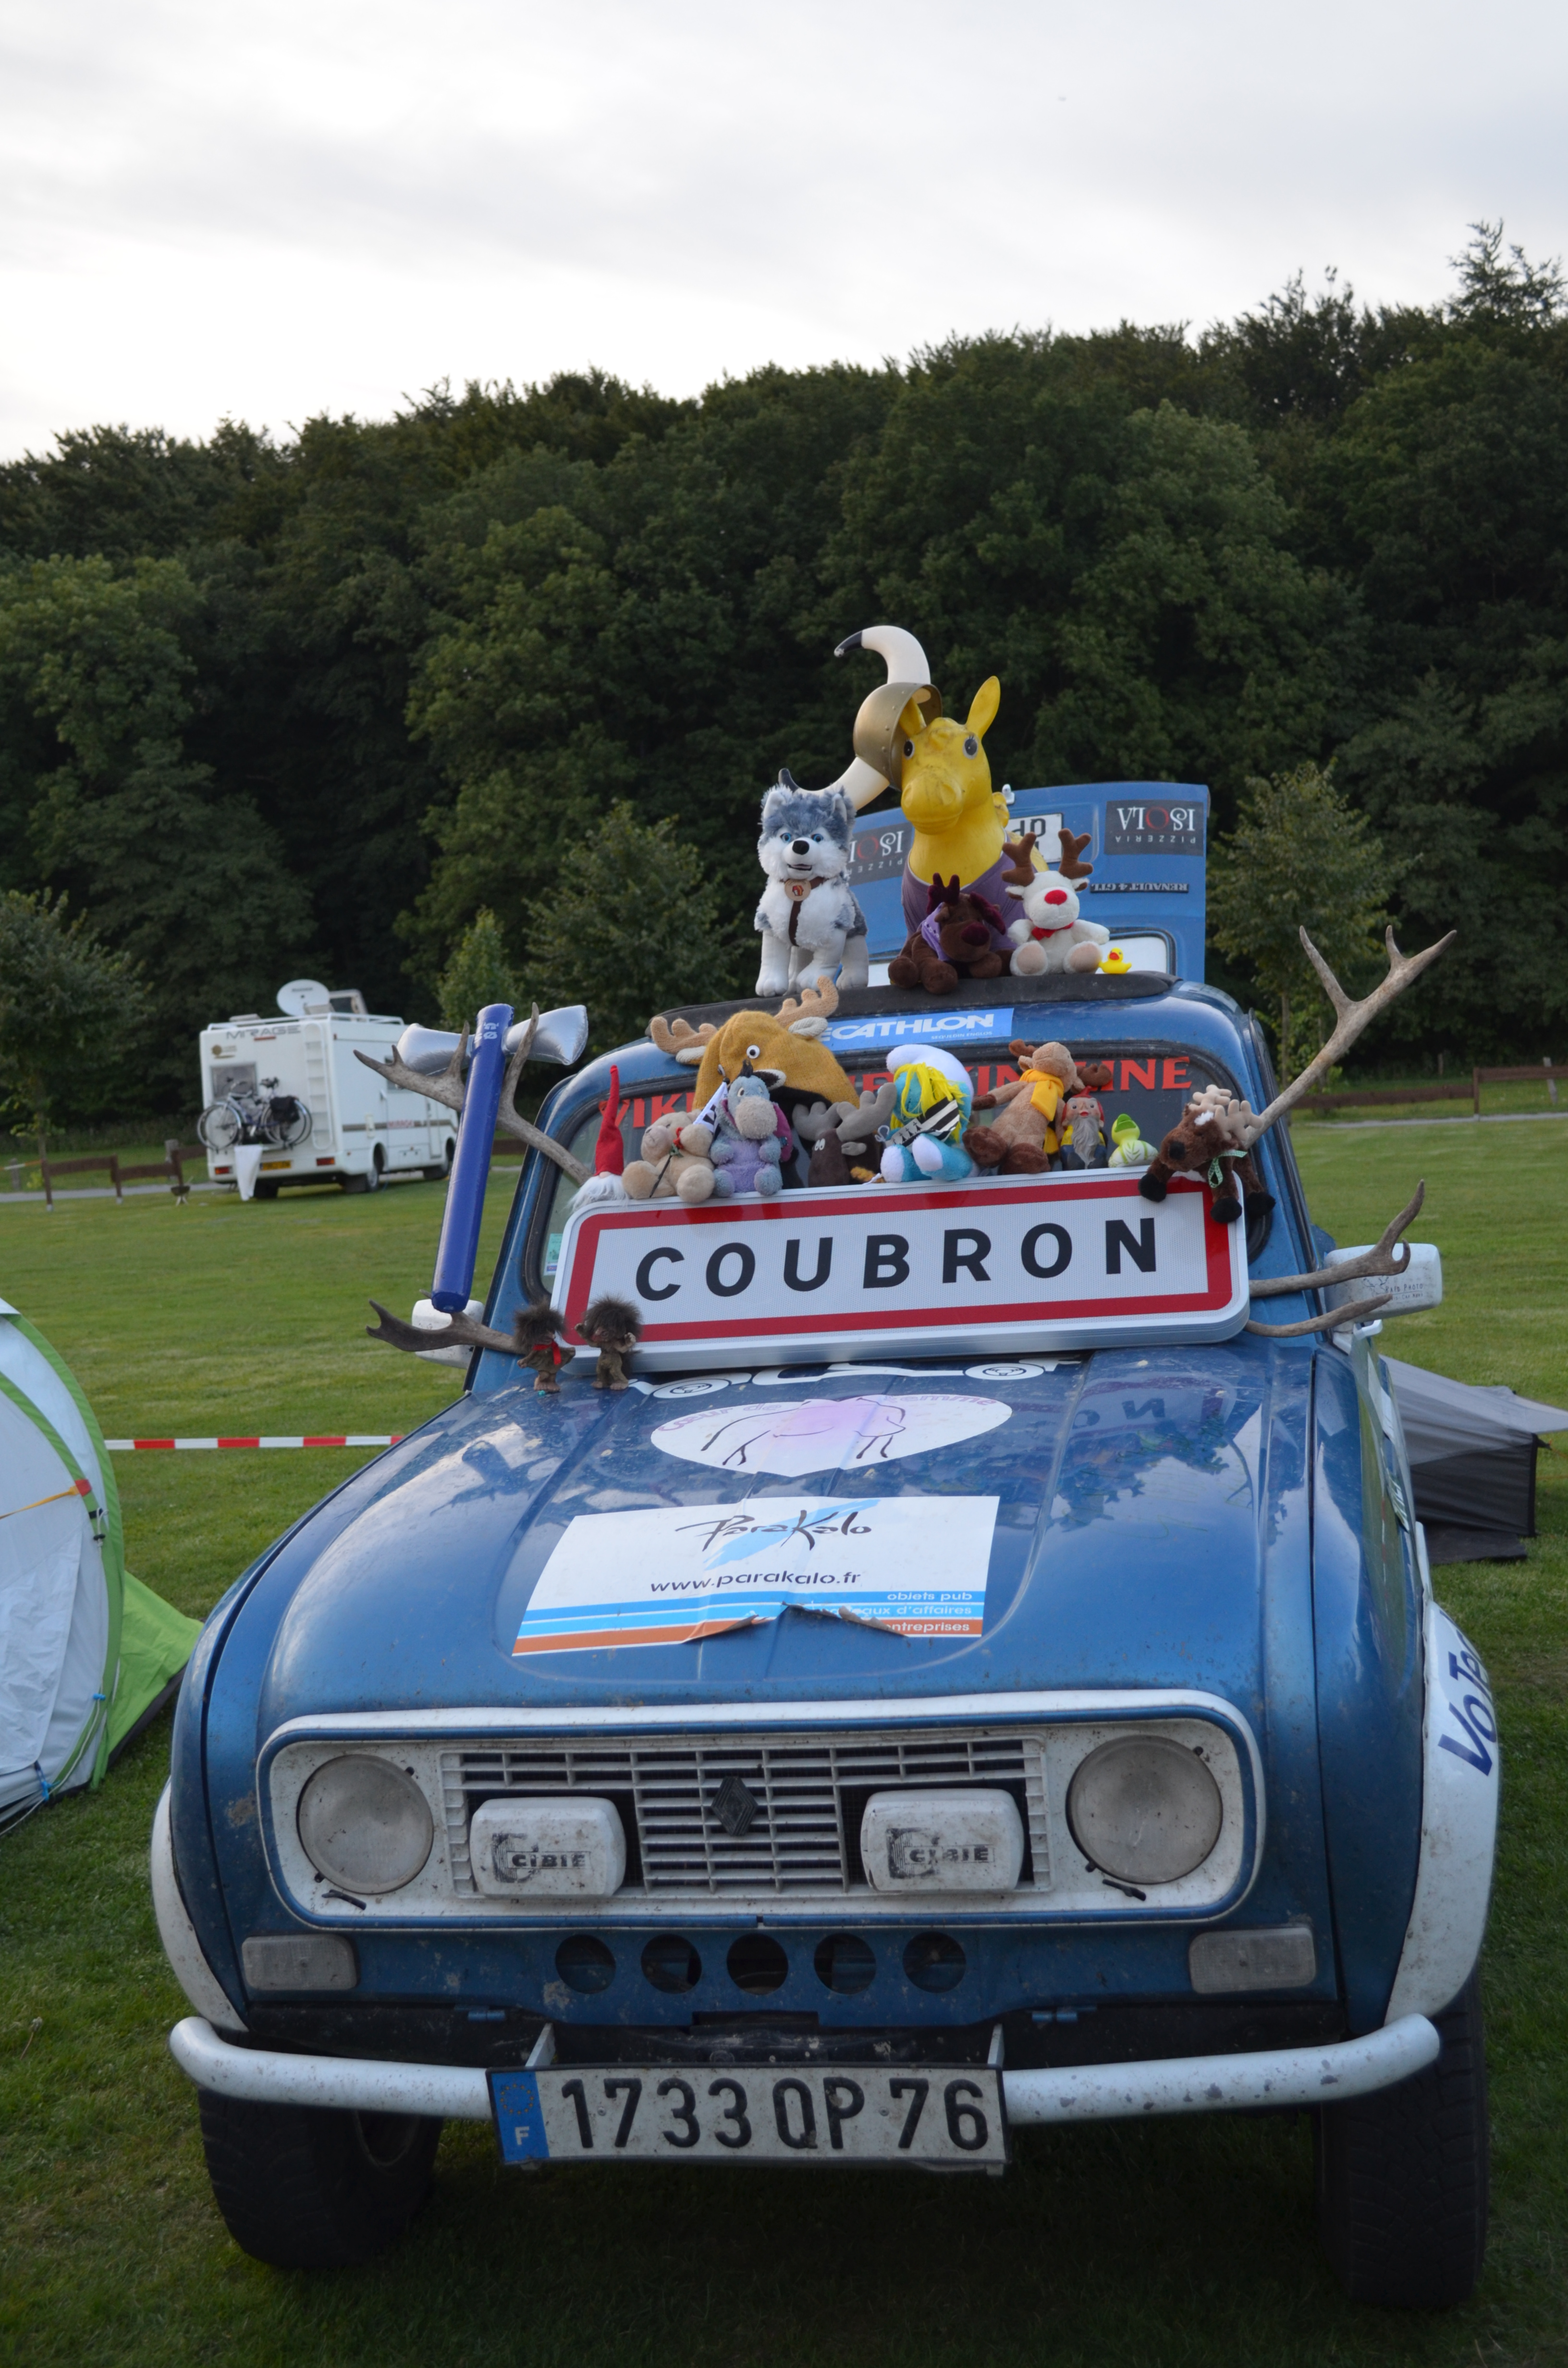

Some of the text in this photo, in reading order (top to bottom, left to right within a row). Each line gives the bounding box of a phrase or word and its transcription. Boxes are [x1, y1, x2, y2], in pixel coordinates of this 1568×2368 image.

[1115, 834, 1196, 844] PIZZERIA
[1130, 883, 1188, 891] RENAULT
[226, 1024, 302, 1039] MIRAGE
[821, 1013, 994, 1042] ECATHLON
[635, 1217, 1156, 1301] COUBRON
[650, 1570, 861, 1592] www.parakalo.fr
[887, 1591, 973, 1602] objets pub
[561, 2076, 989, 2151] 1733 QP 76
[514, 2126, 529, 2146] F
